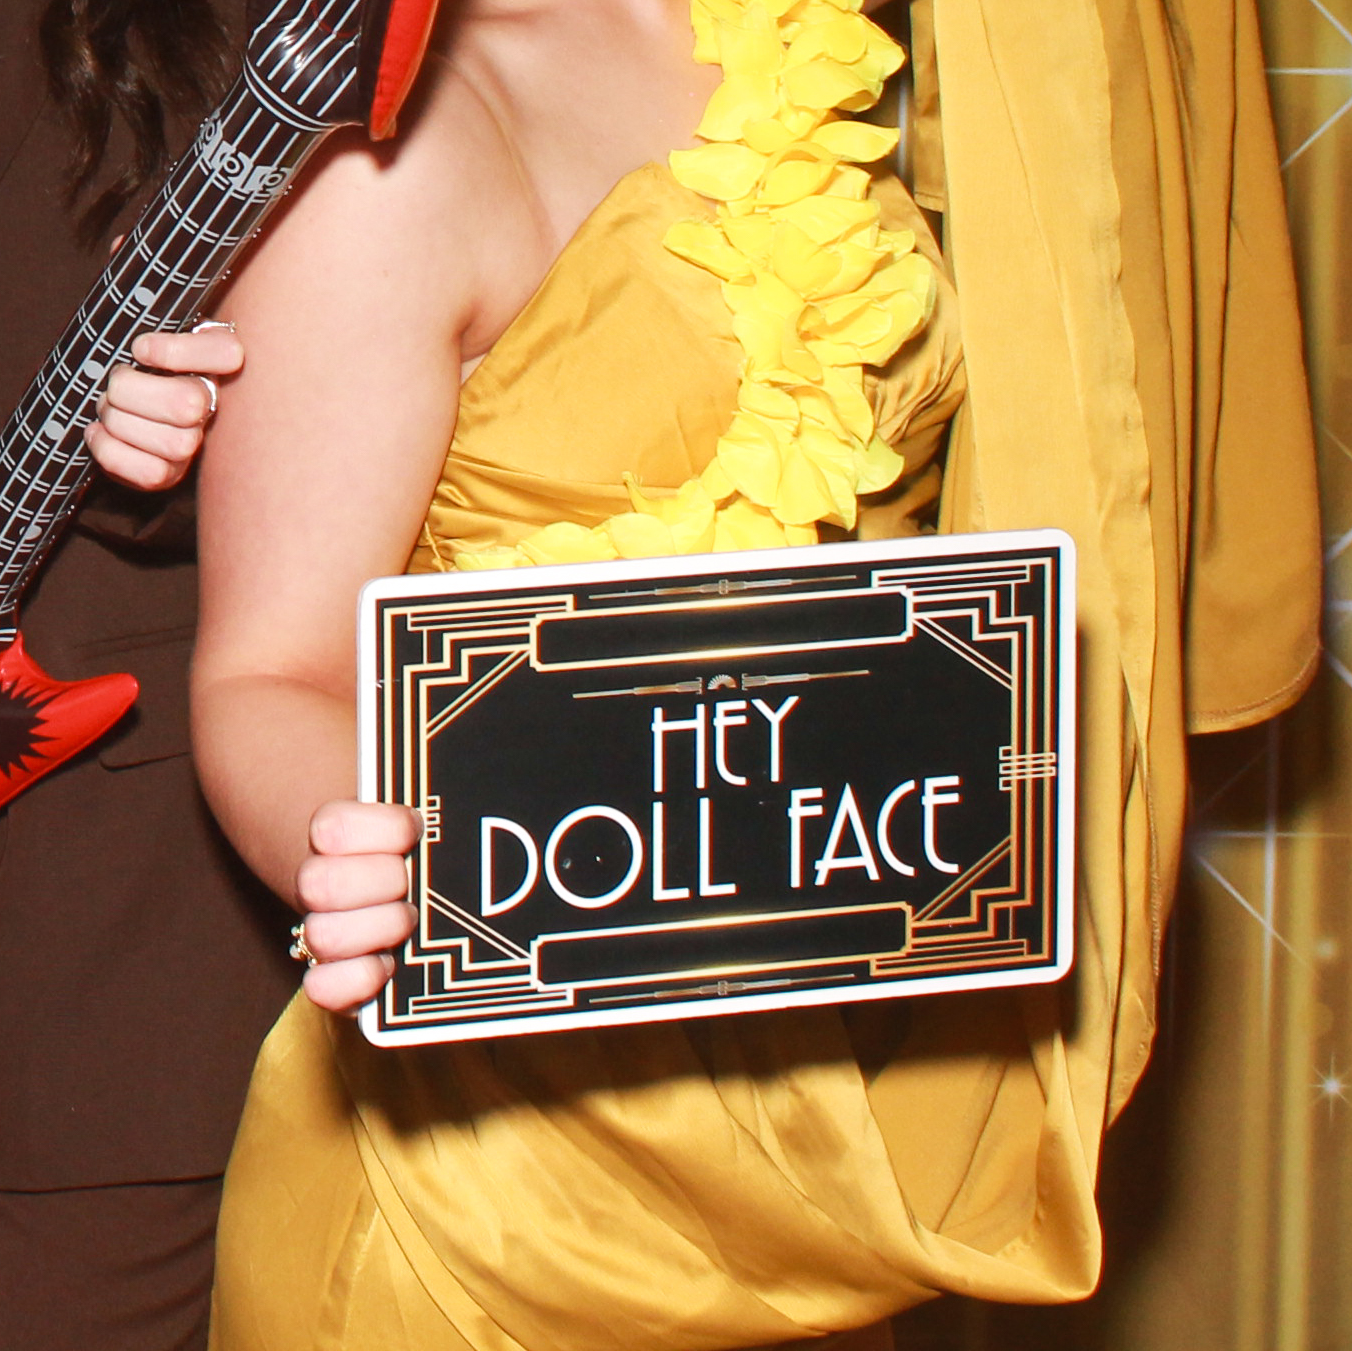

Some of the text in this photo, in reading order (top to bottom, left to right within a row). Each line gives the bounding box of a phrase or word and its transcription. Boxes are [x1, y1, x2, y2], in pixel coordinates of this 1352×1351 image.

[650, 694, 801, 794] HEY
[480, 774, 962, 918] DOLL FACE
